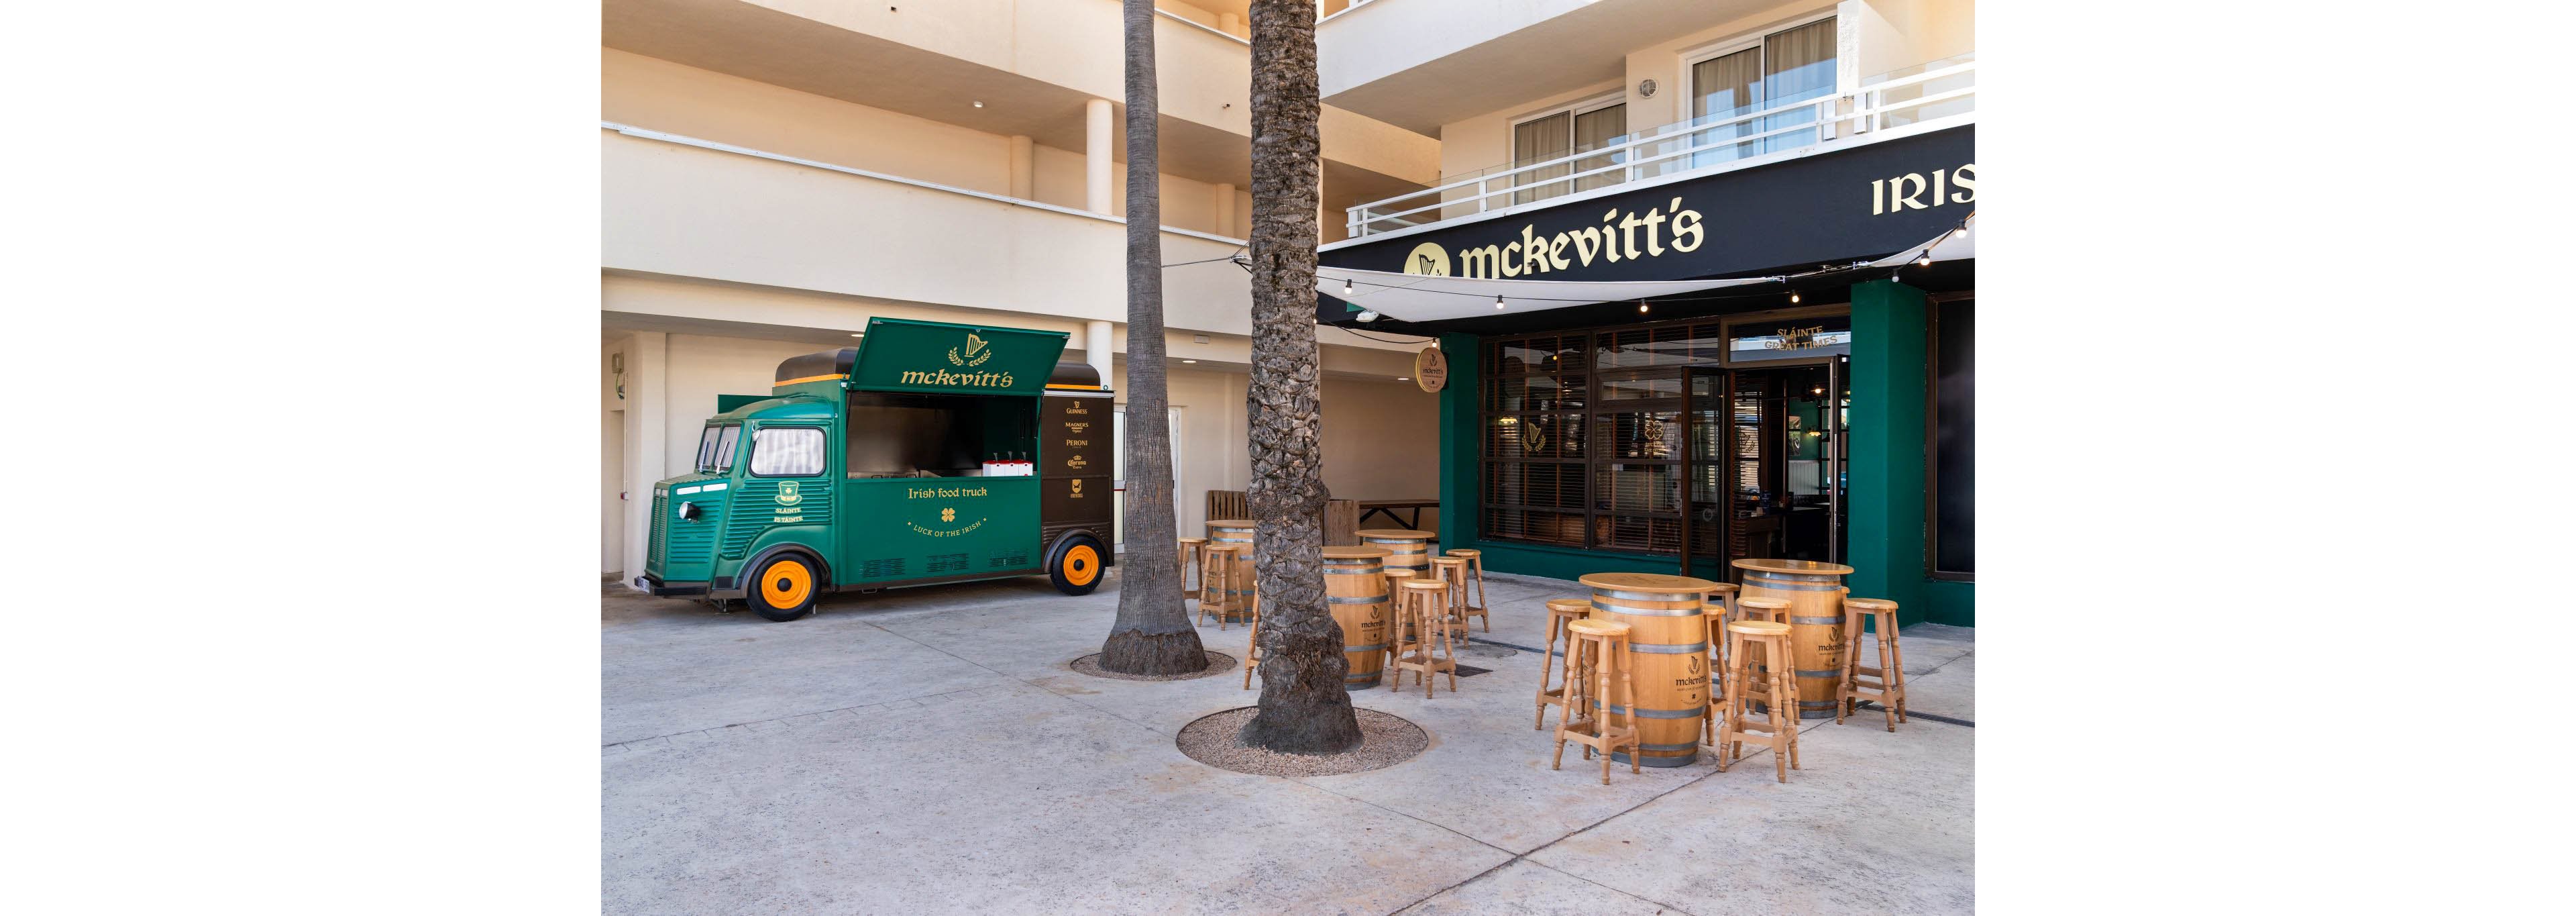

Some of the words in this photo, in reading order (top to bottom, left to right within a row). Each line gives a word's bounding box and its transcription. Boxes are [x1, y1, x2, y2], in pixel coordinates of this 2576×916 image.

[1460, 197, 1704, 279] mckevitt's
[1764, 340, 1800, 351] GREAT
[1802, 336, 1837, 350] TIMES
[901, 368, 1014, 388] mckevitt's
[1067, 459, 1087, 467] Corona
[908, 488, 935, 499] Irish
[938, 487, 960, 498] food
[962, 487, 987, 497] truck
[913, 525, 933, 536] LUCK
[947, 529, 961, 538] THE
[962, 521, 981, 534] IRISH
